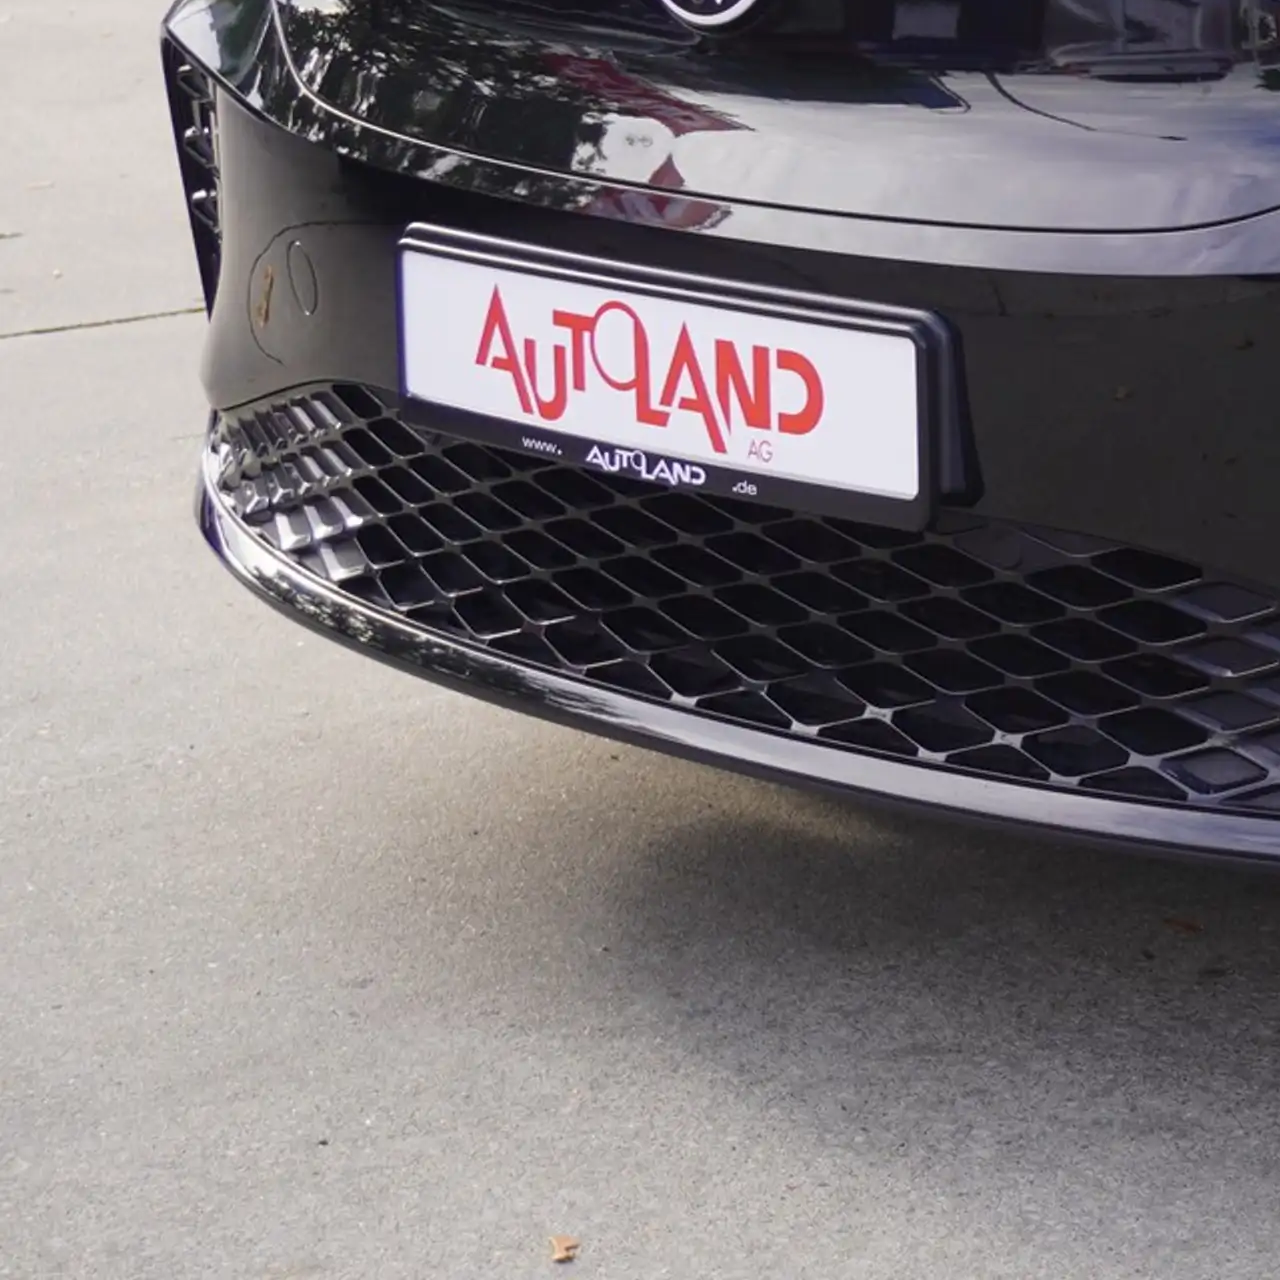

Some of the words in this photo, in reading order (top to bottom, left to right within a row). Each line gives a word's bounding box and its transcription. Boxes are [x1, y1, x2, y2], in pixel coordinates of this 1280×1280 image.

[474, 283, 824, 454] AUTOLAND
[521, 435, 563, 456] www.
[585, 445, 707, 486] AUTOLAND
[731, 480, 758, 496] .de
[747, 439, 774, 463] AG
